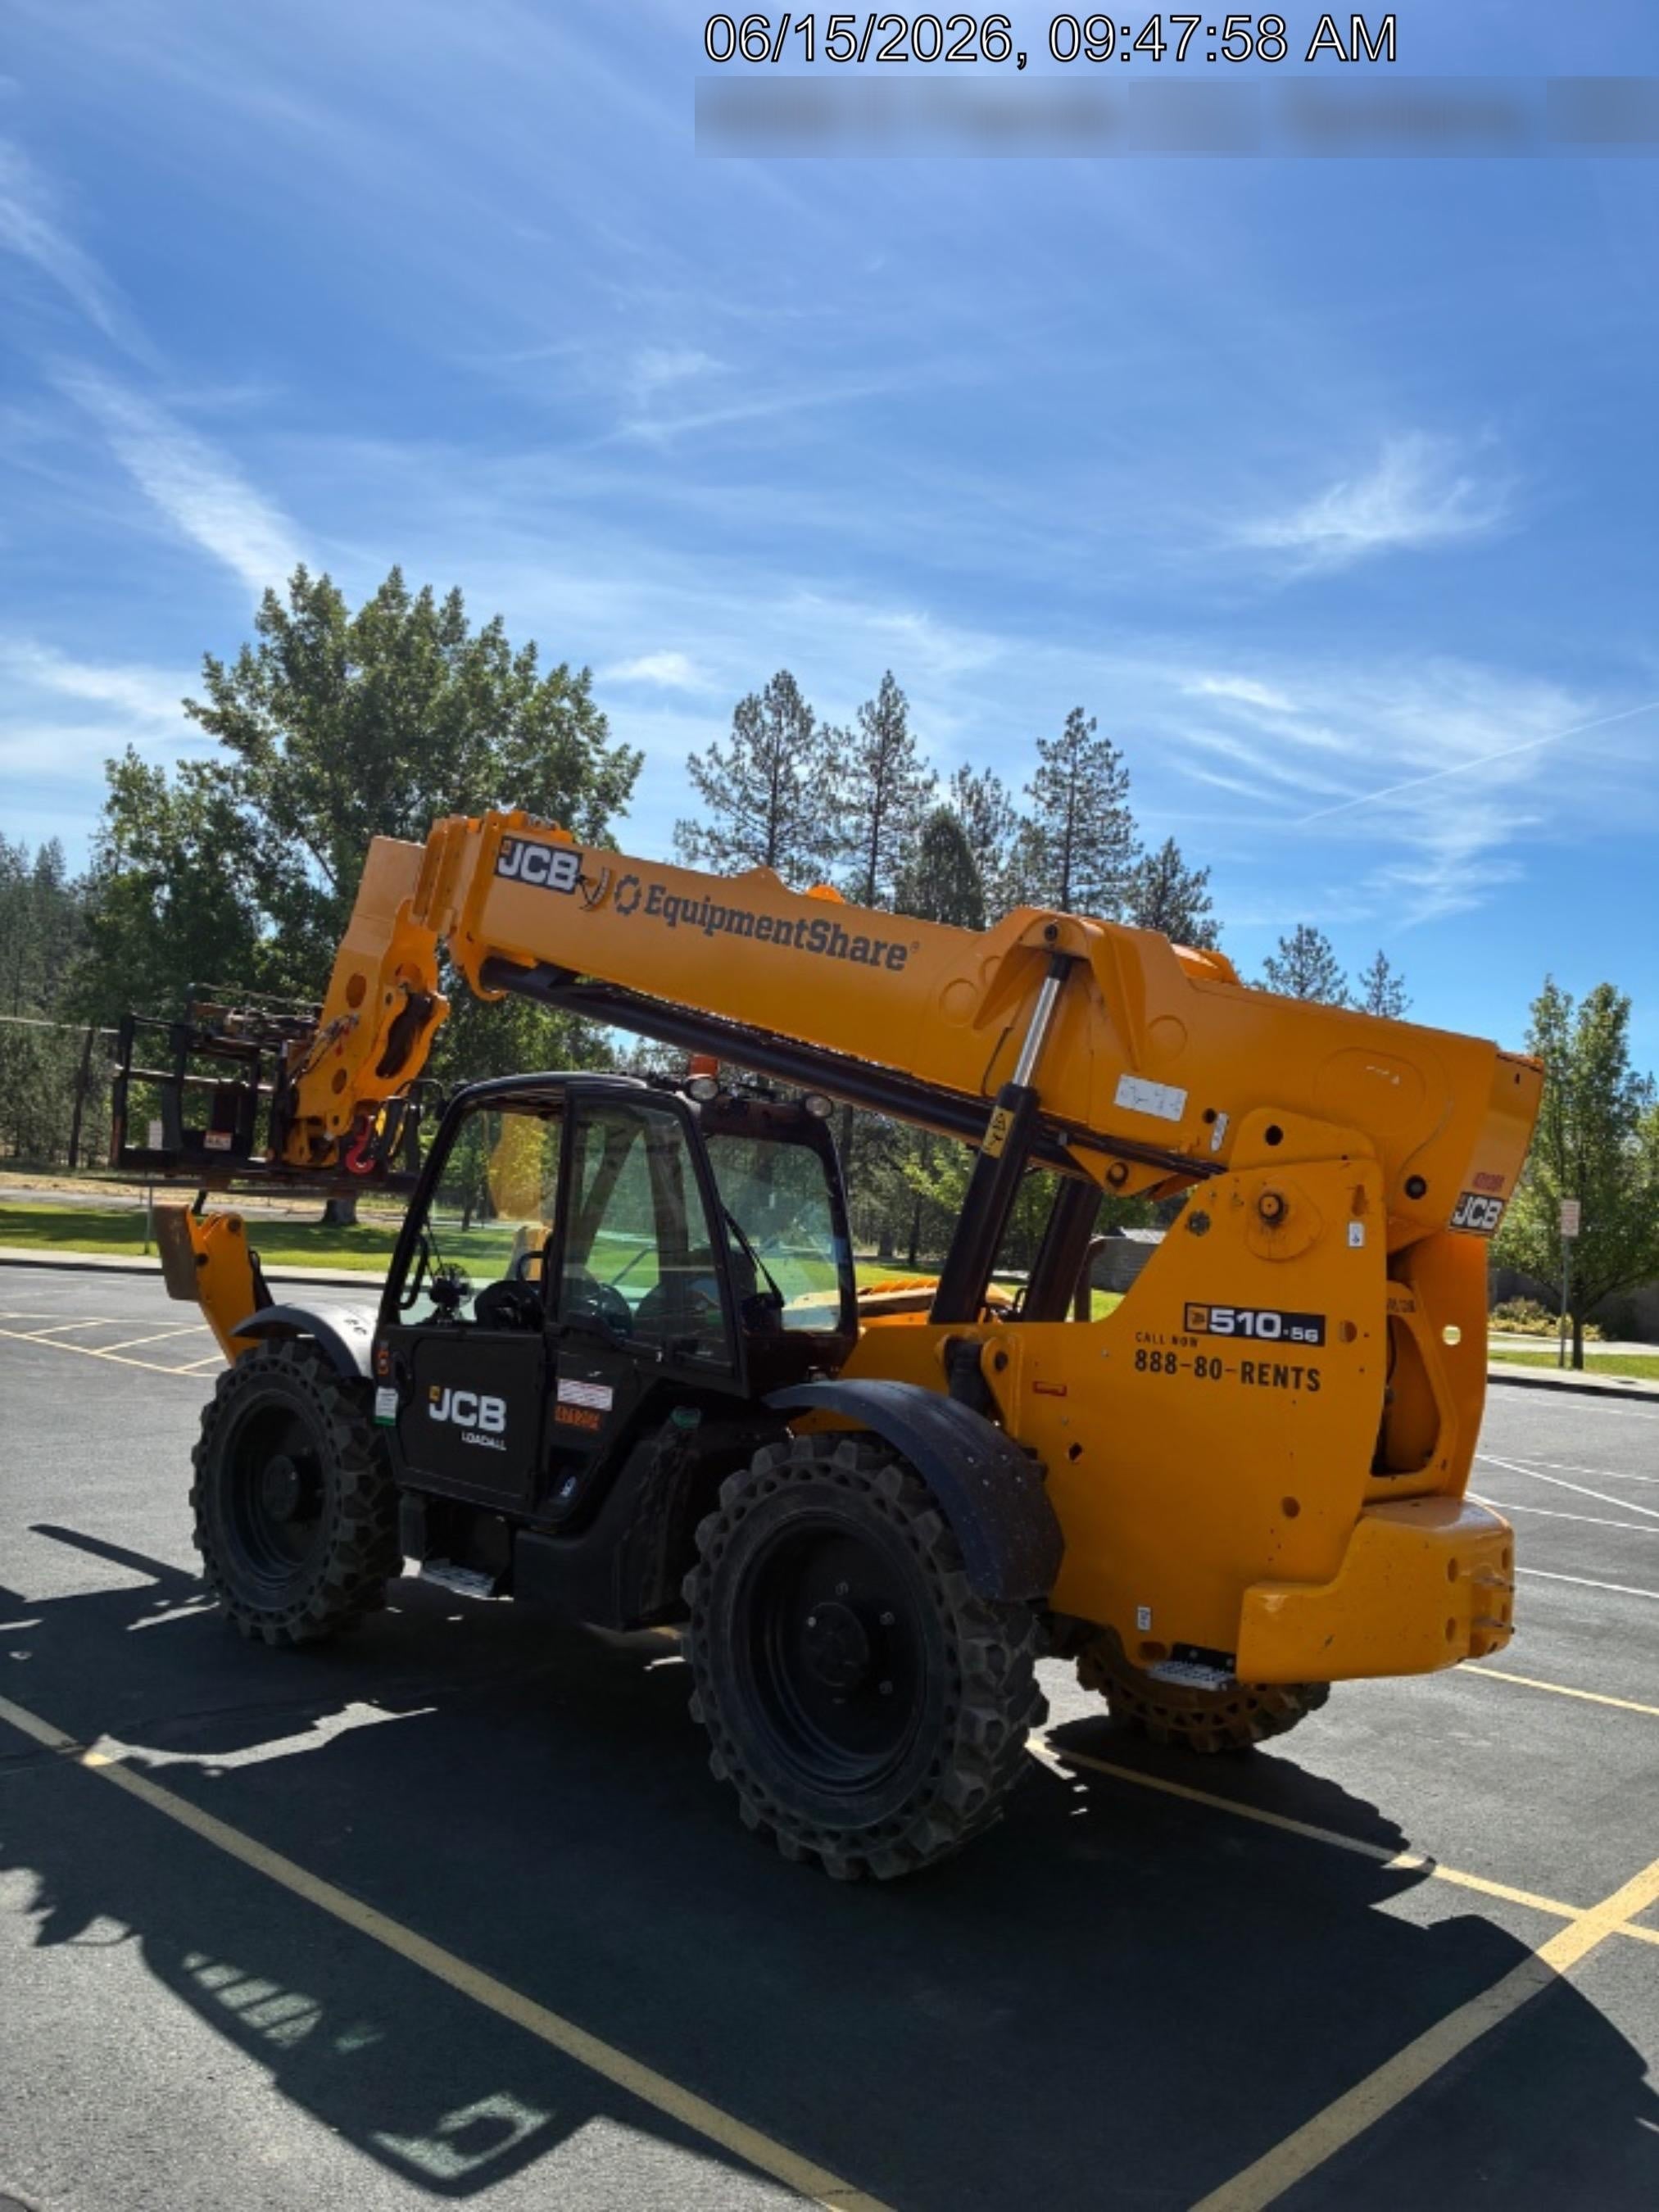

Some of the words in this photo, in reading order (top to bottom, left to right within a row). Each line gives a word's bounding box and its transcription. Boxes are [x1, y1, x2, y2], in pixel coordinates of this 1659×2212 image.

[497, 841, 579, 891] JCB
[643, 883, 909, 972] EquipmentShare
[1453, 1196, 1503, 1229] JCB
[1135, 1331, 1165, 1346] CALL
[1172, 1334, 1199, 1348] NOW
[1135, 1349, 1321, 1392] 888-80-RENTS
[428, 1387, 506, 1434] JCB
